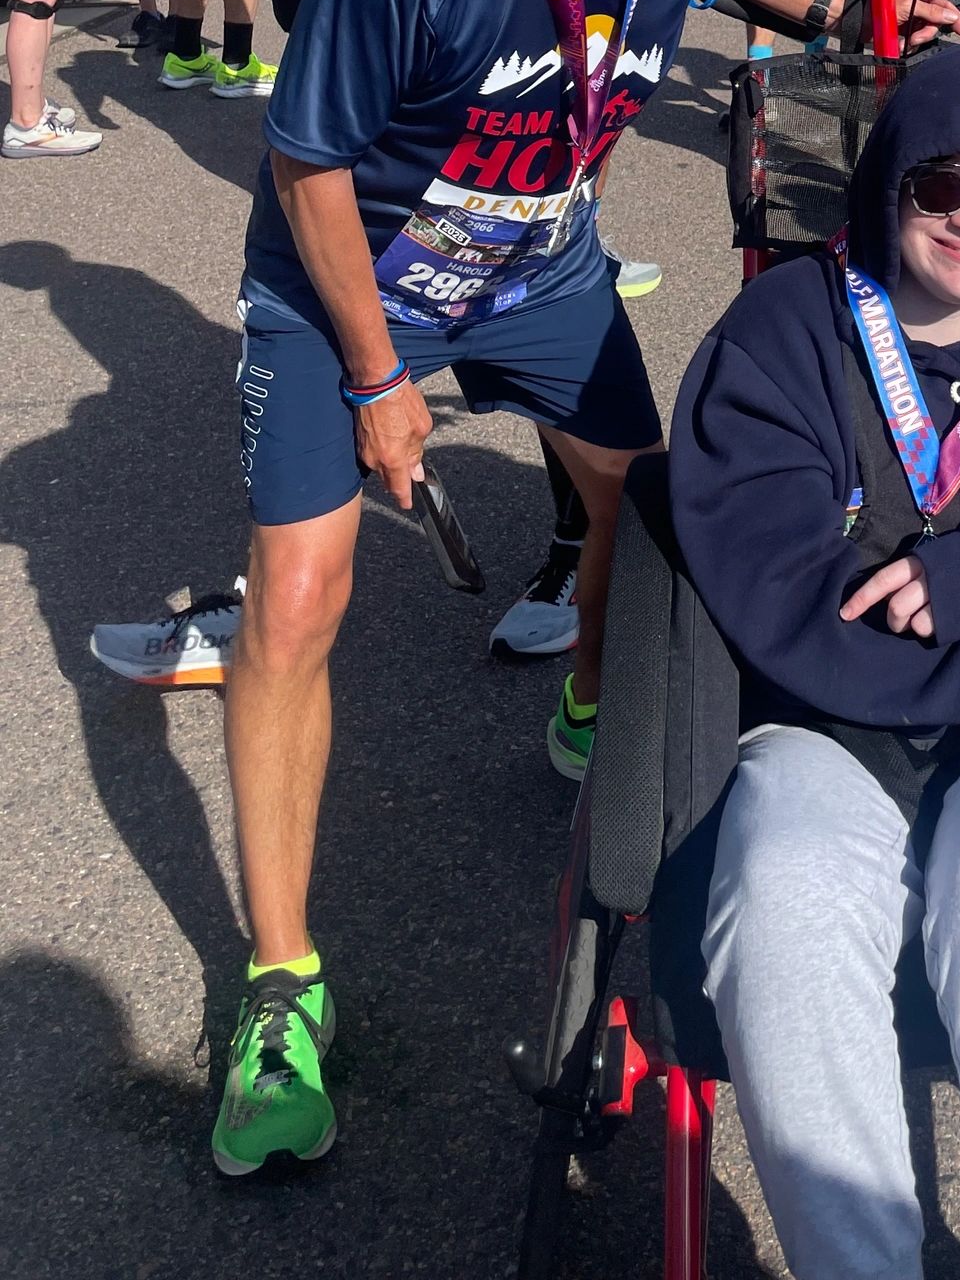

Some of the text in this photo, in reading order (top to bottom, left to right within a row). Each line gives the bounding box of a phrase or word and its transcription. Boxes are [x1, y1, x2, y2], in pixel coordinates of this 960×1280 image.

[466, 106, 554, 137] TEAM
[440, 131, 621, 193] HOY
[463, 195, 569, 220] DENVE
[441, 223, 466, 242] 2025
[464, 220, 495, 233] 2966
[446, 262, 493, 276] HAROLD
[859, 293, 926, 436] MARATHON
[144, 633, 234, 657] BROOK
